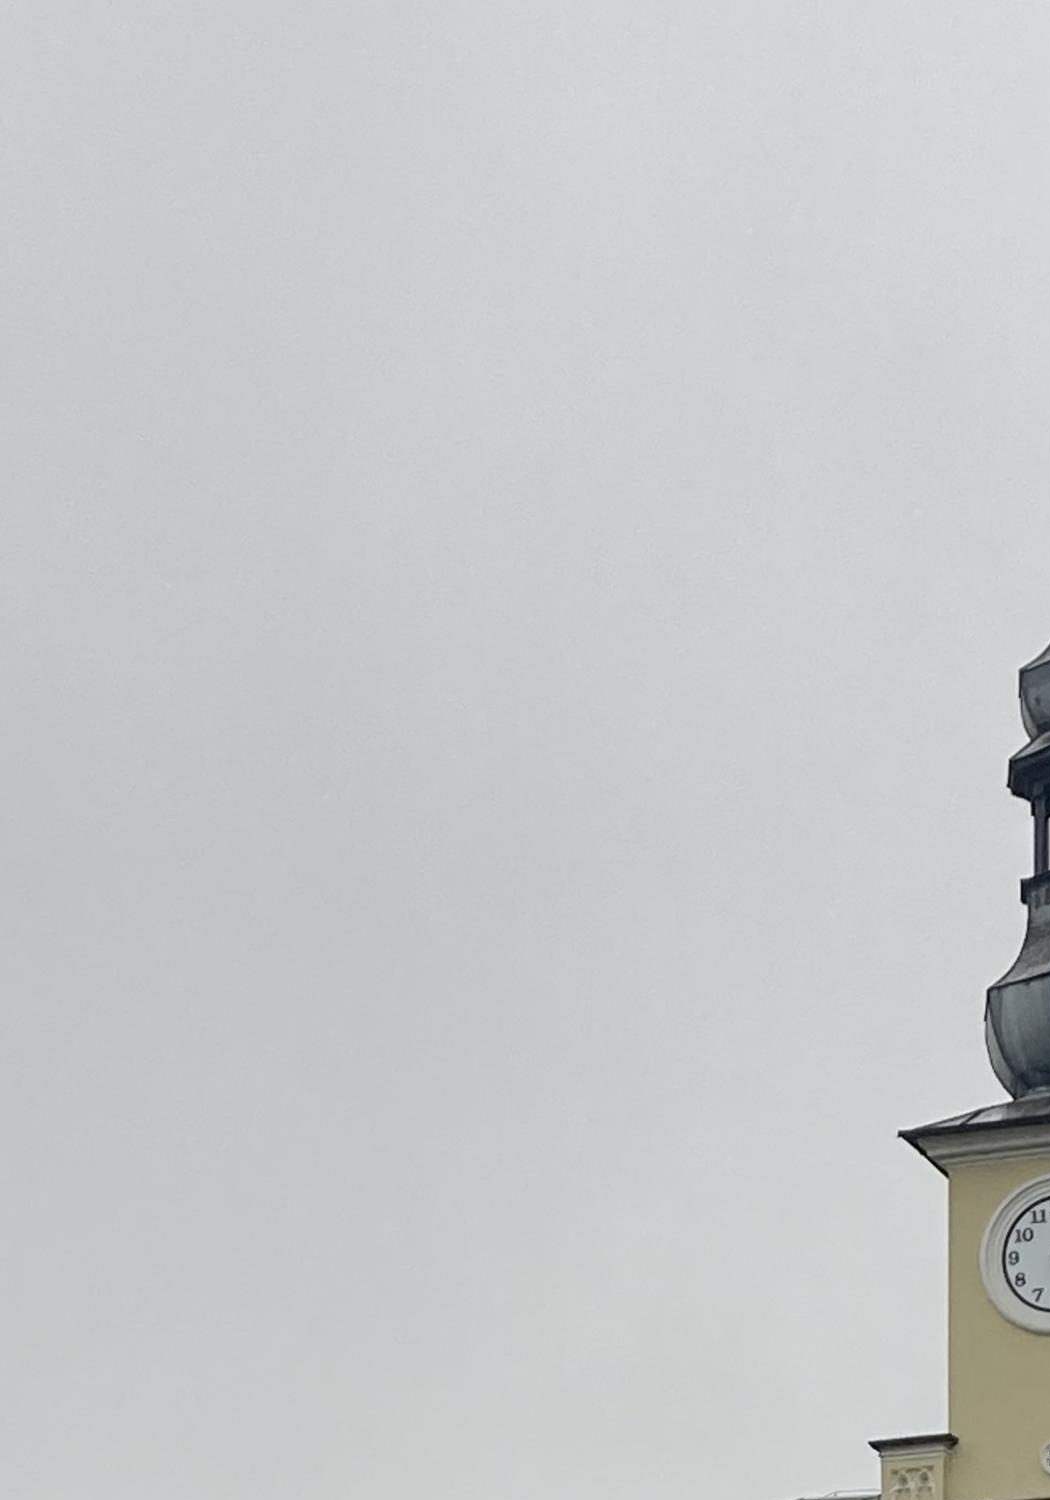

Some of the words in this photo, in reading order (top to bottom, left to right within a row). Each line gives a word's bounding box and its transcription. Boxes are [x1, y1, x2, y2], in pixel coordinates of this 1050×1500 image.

[1031, 1209, 1046, 1224] 11
[1015, 1227, 1034, 1243] 10
[1008, 1251, 1020, 1265] 9
[1015, 1272, 1026, 1287] 8
[1032, 1288, 1044, 1302] 7
